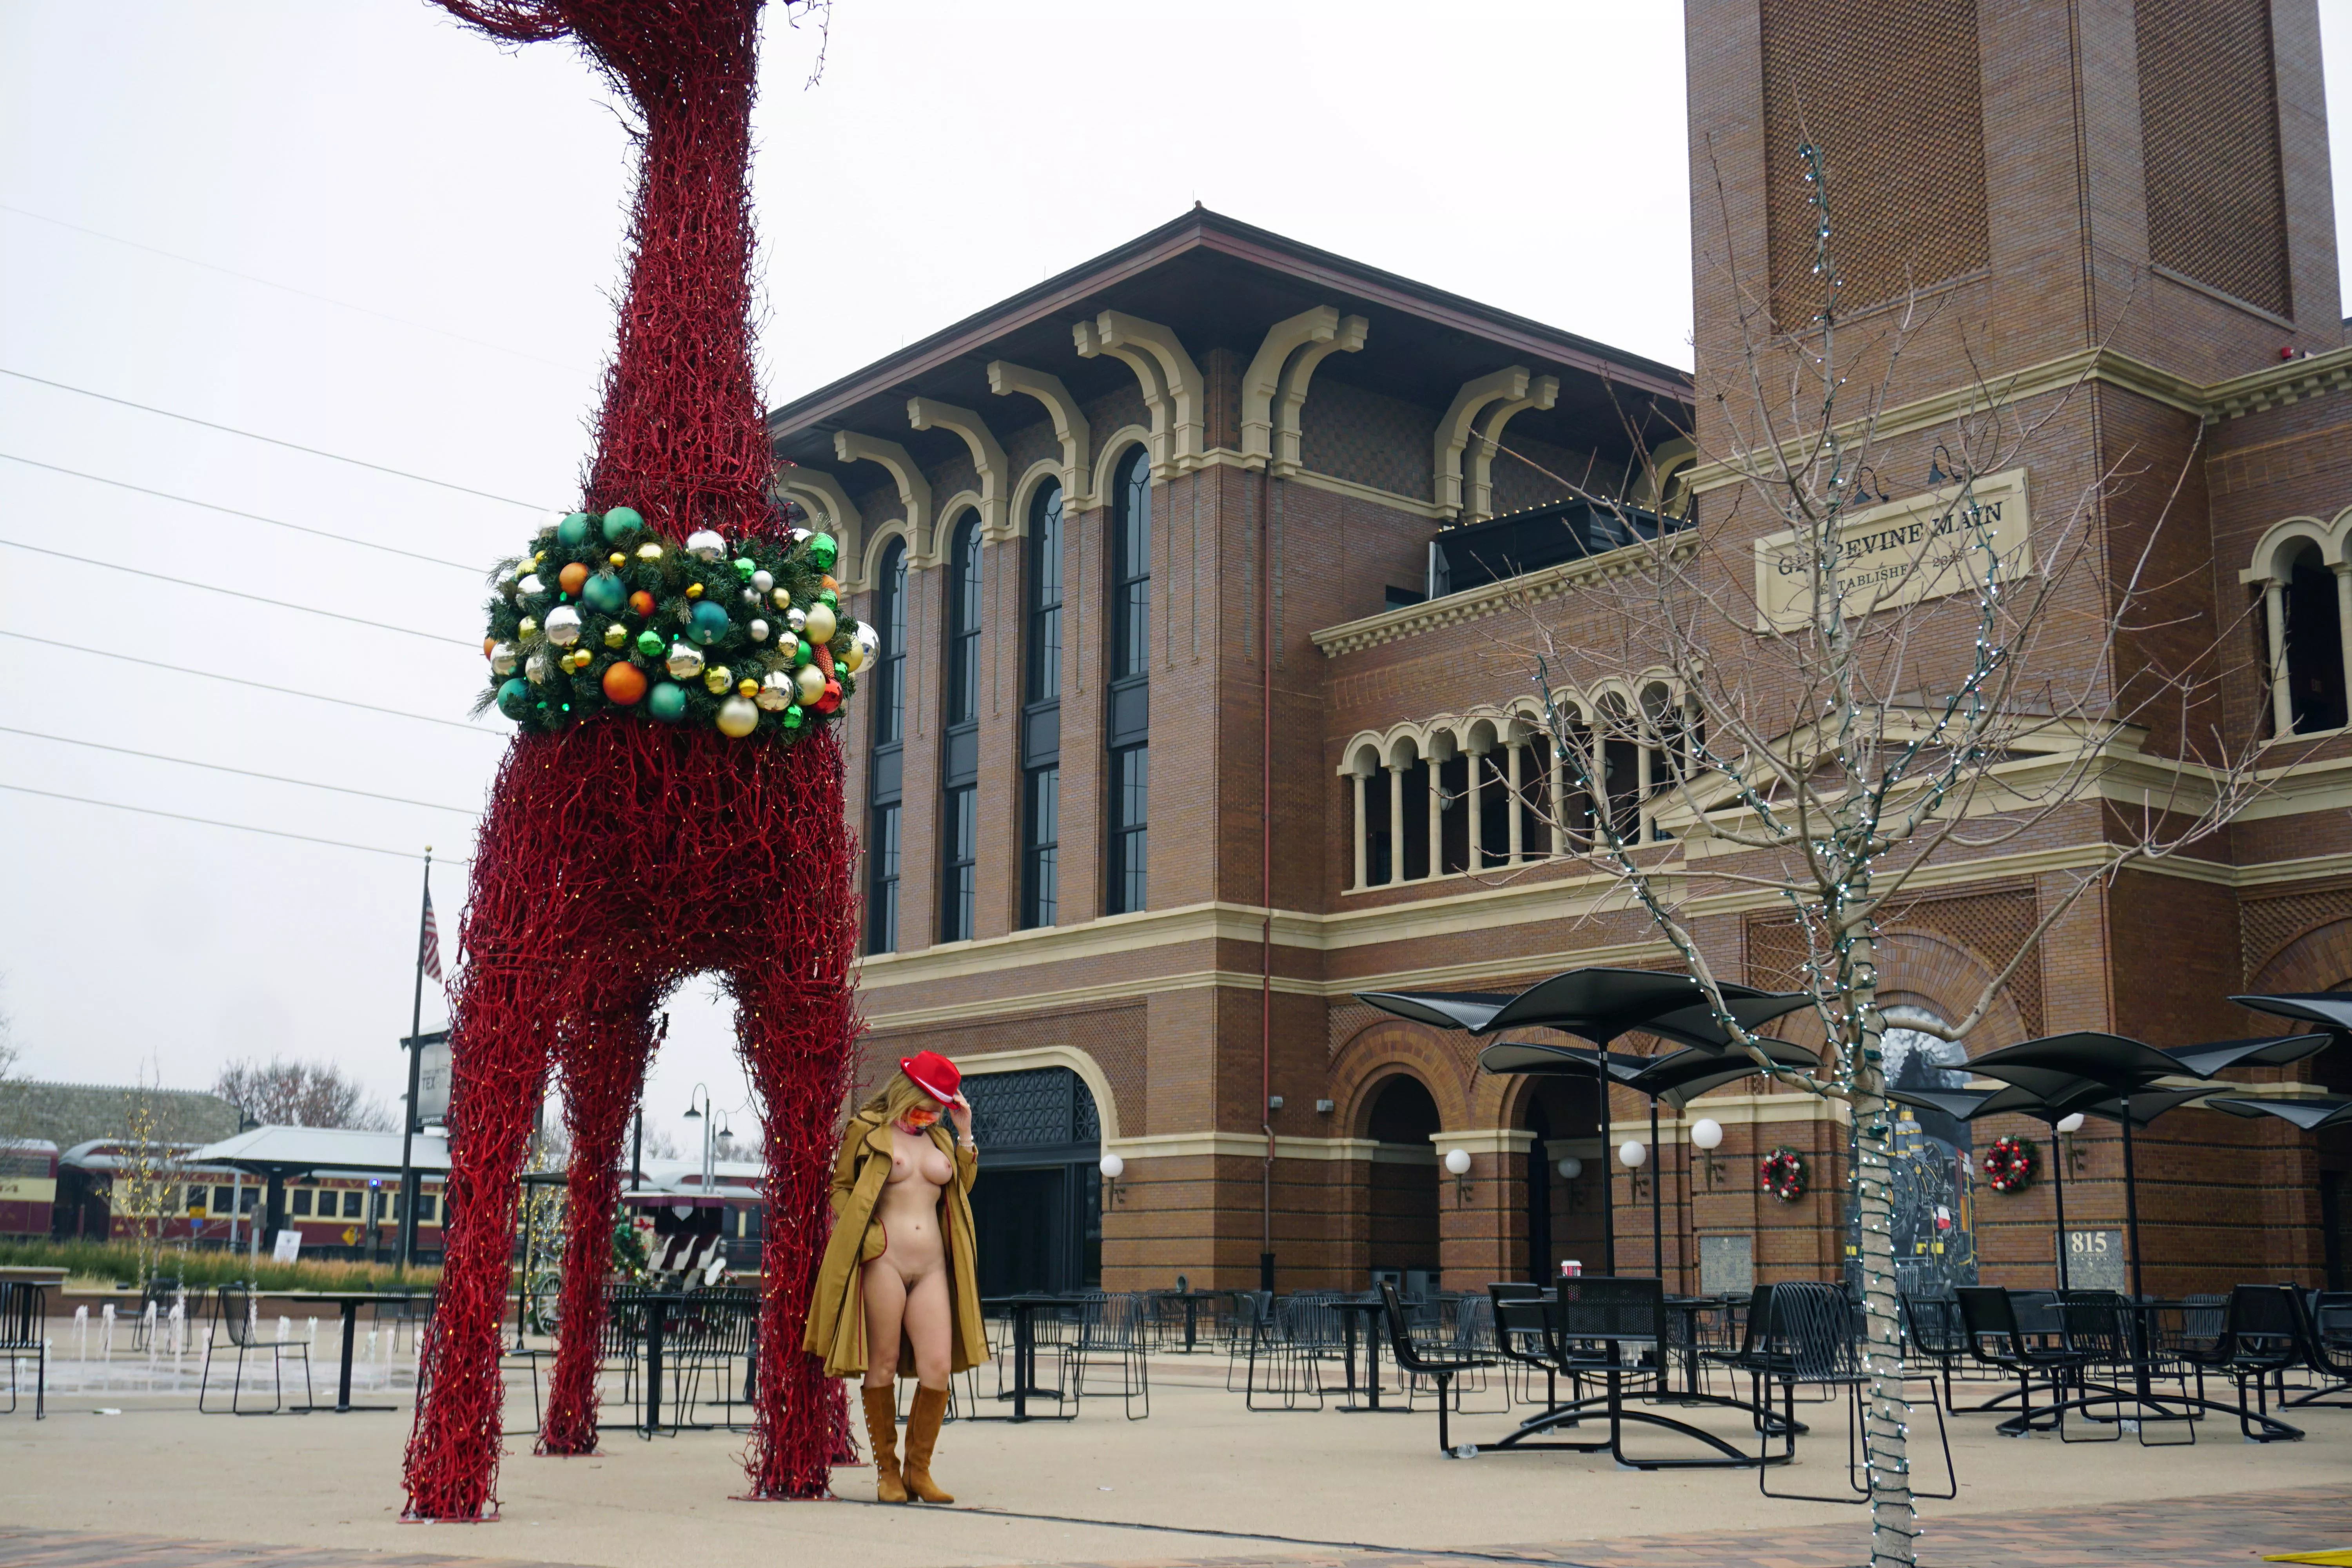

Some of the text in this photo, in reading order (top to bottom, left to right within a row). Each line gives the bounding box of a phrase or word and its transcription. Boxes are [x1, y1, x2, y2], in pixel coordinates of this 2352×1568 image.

[1932, 502, 2003, 536] MAN
[1820, 563, 1919, 595] ETABLISHE
[2072, 1232, 2107, 1252] 815
